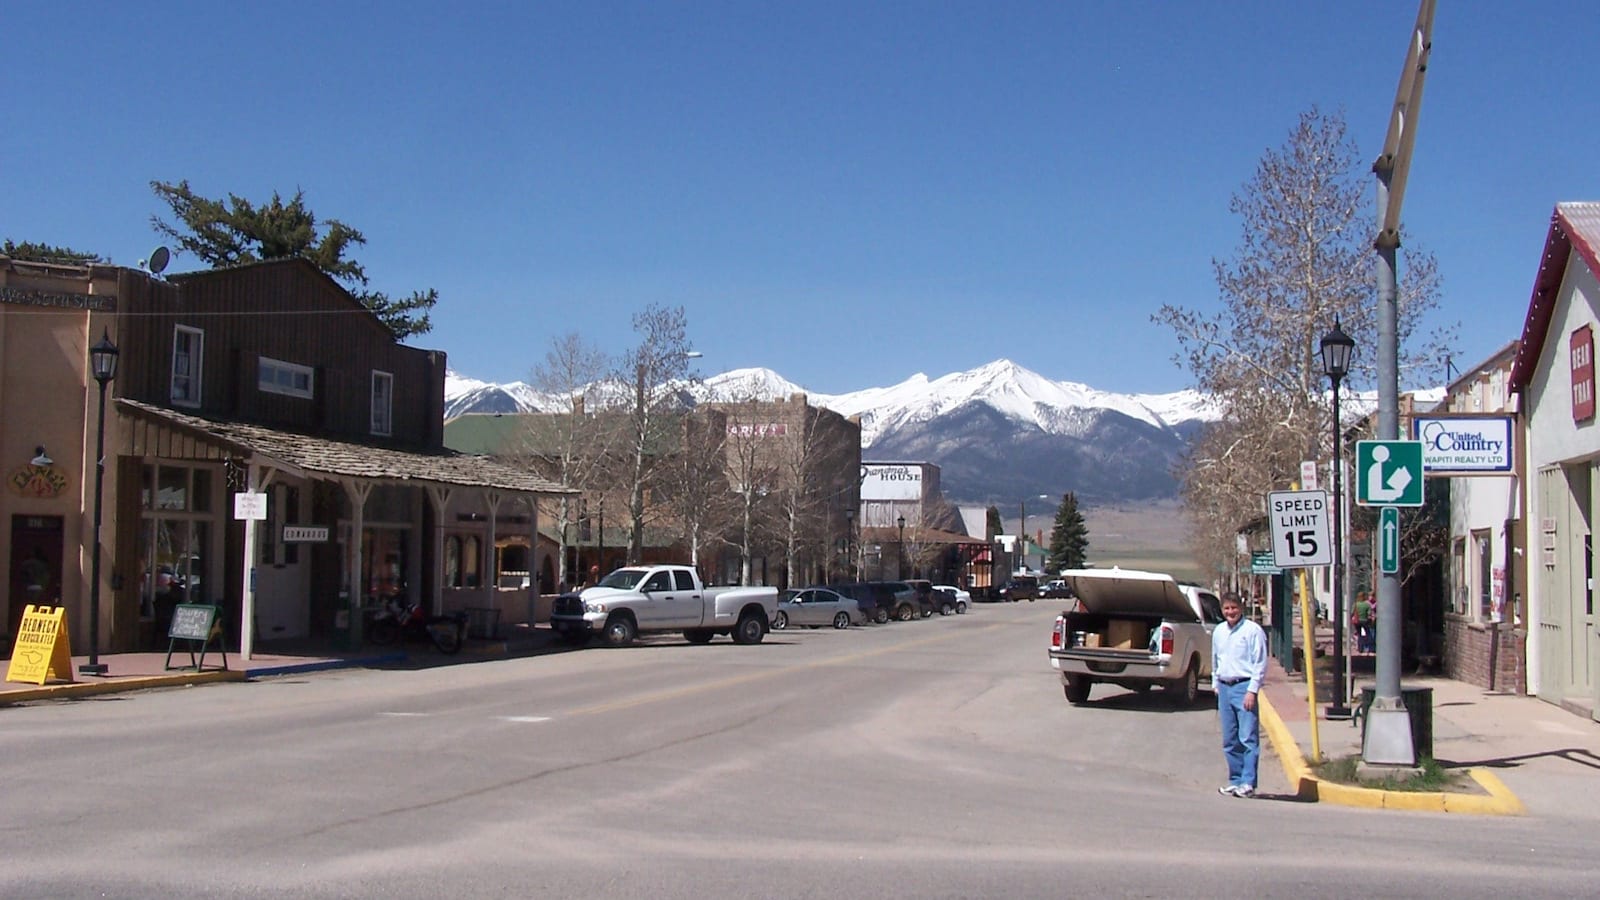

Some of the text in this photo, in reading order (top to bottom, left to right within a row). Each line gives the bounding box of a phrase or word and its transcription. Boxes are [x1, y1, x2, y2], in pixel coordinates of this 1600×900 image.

[1572, 343, 1590, 370] BEAR
[1450, 431, 1482, 441] United
[1435, 431, 1504, 455] Country
[1424, 455, 1503, 464] WAPITI REALTY LTD
[881, 473, 921, 481] HOUSE
[1275, 499, 1323, 512] SPEED
[1281, 515, 1318, 527] LIMIT
[1285, 530, 1318, 557] 15
[22, 617, 59, 634] REDNECK
